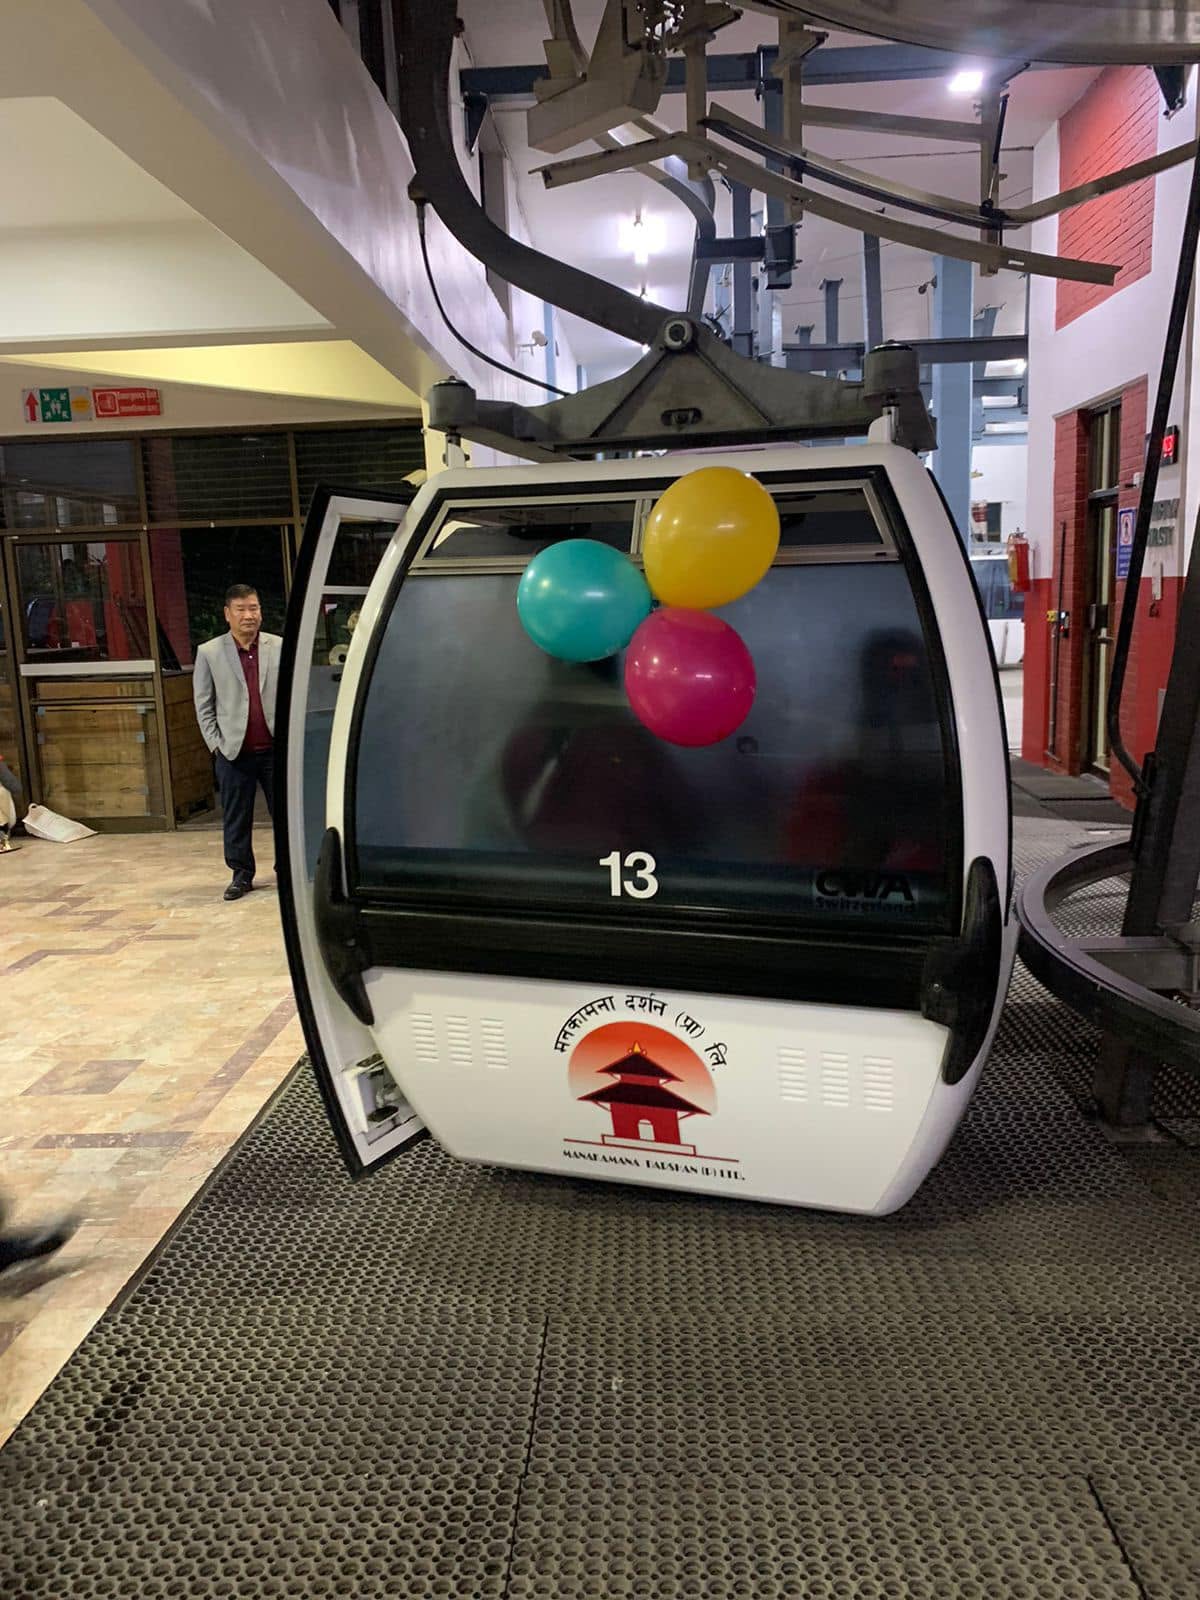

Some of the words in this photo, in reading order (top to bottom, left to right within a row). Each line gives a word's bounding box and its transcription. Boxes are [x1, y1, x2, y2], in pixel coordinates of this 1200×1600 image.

[599, 850, 659, 899] 13
[554, 995, 616, 1053] मनकामना
[625, 993, 668, 1017] दर्शन
